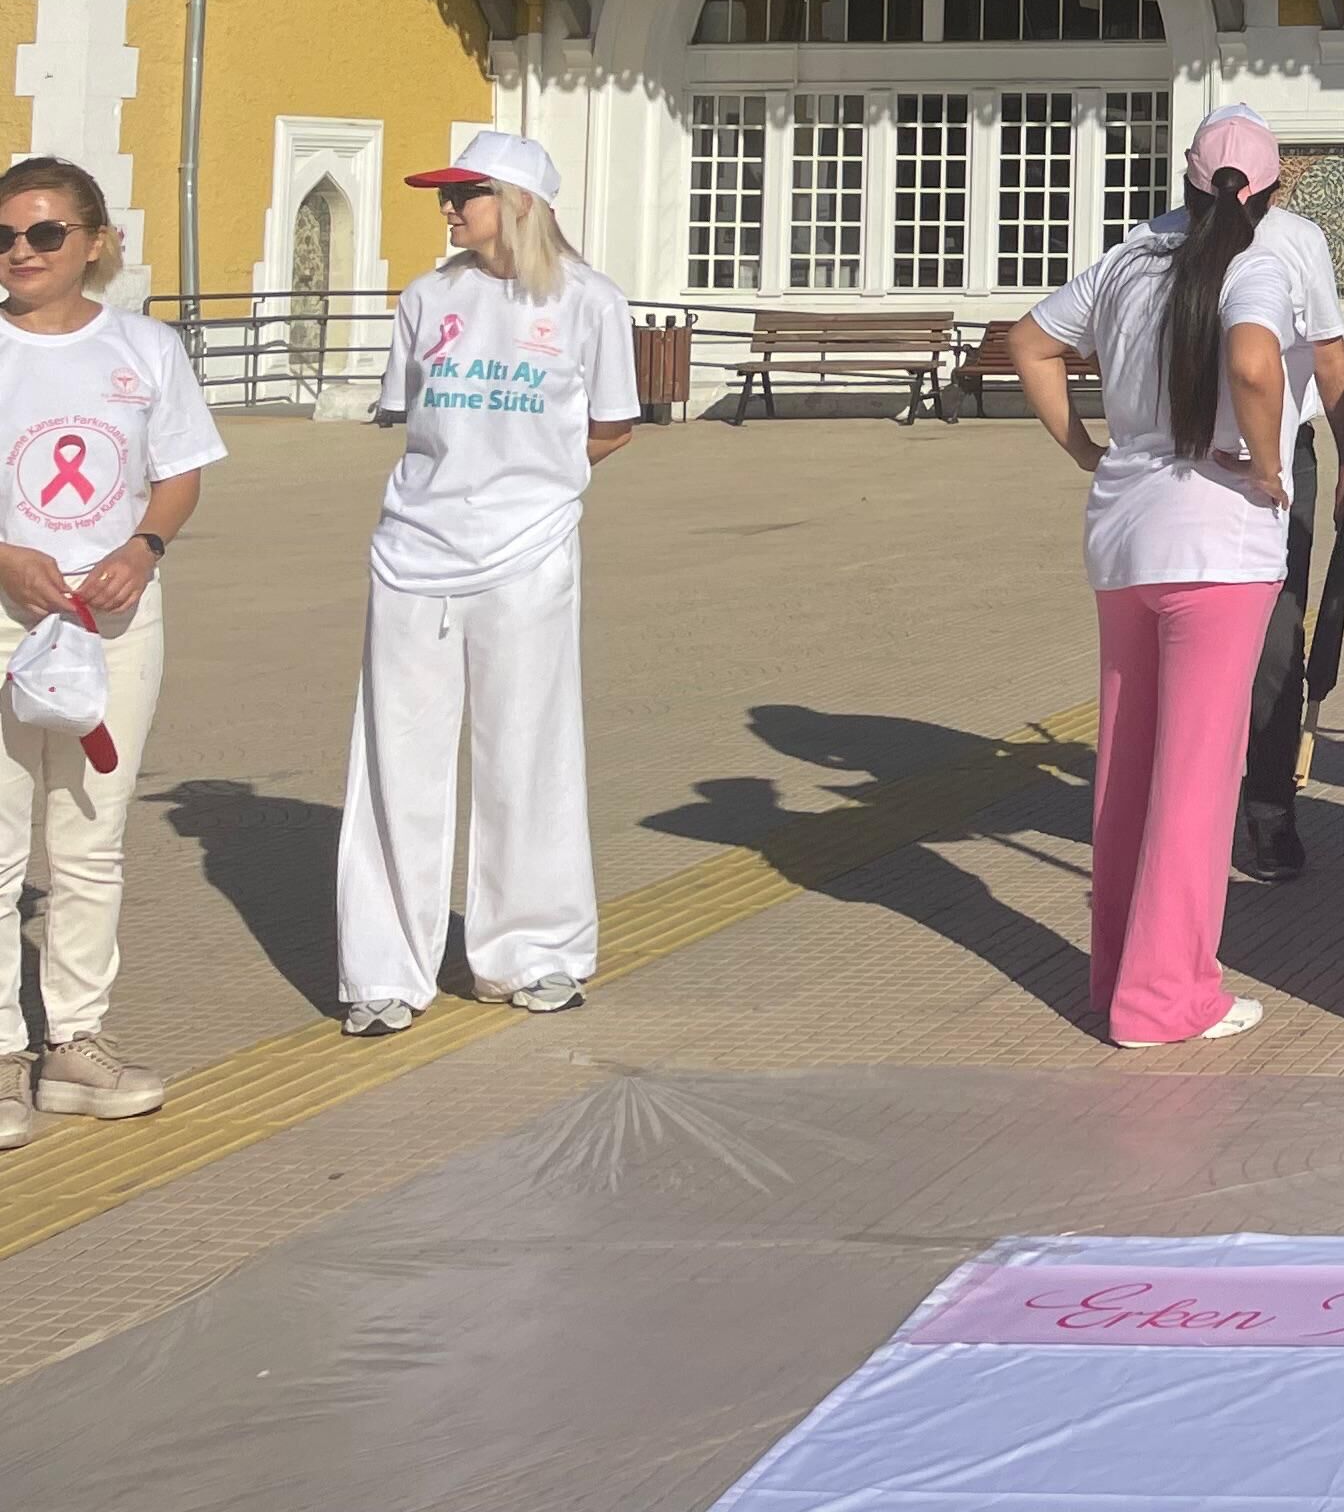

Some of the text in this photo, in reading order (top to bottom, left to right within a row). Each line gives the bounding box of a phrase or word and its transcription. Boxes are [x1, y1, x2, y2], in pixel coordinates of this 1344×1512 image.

[465, 359, 509, 380] Altı
[512, 361, 547, 388] Ay
[424, 387, 545, 414] Anne Sütü
[1025, 1282, 1278, 1333] Erken
